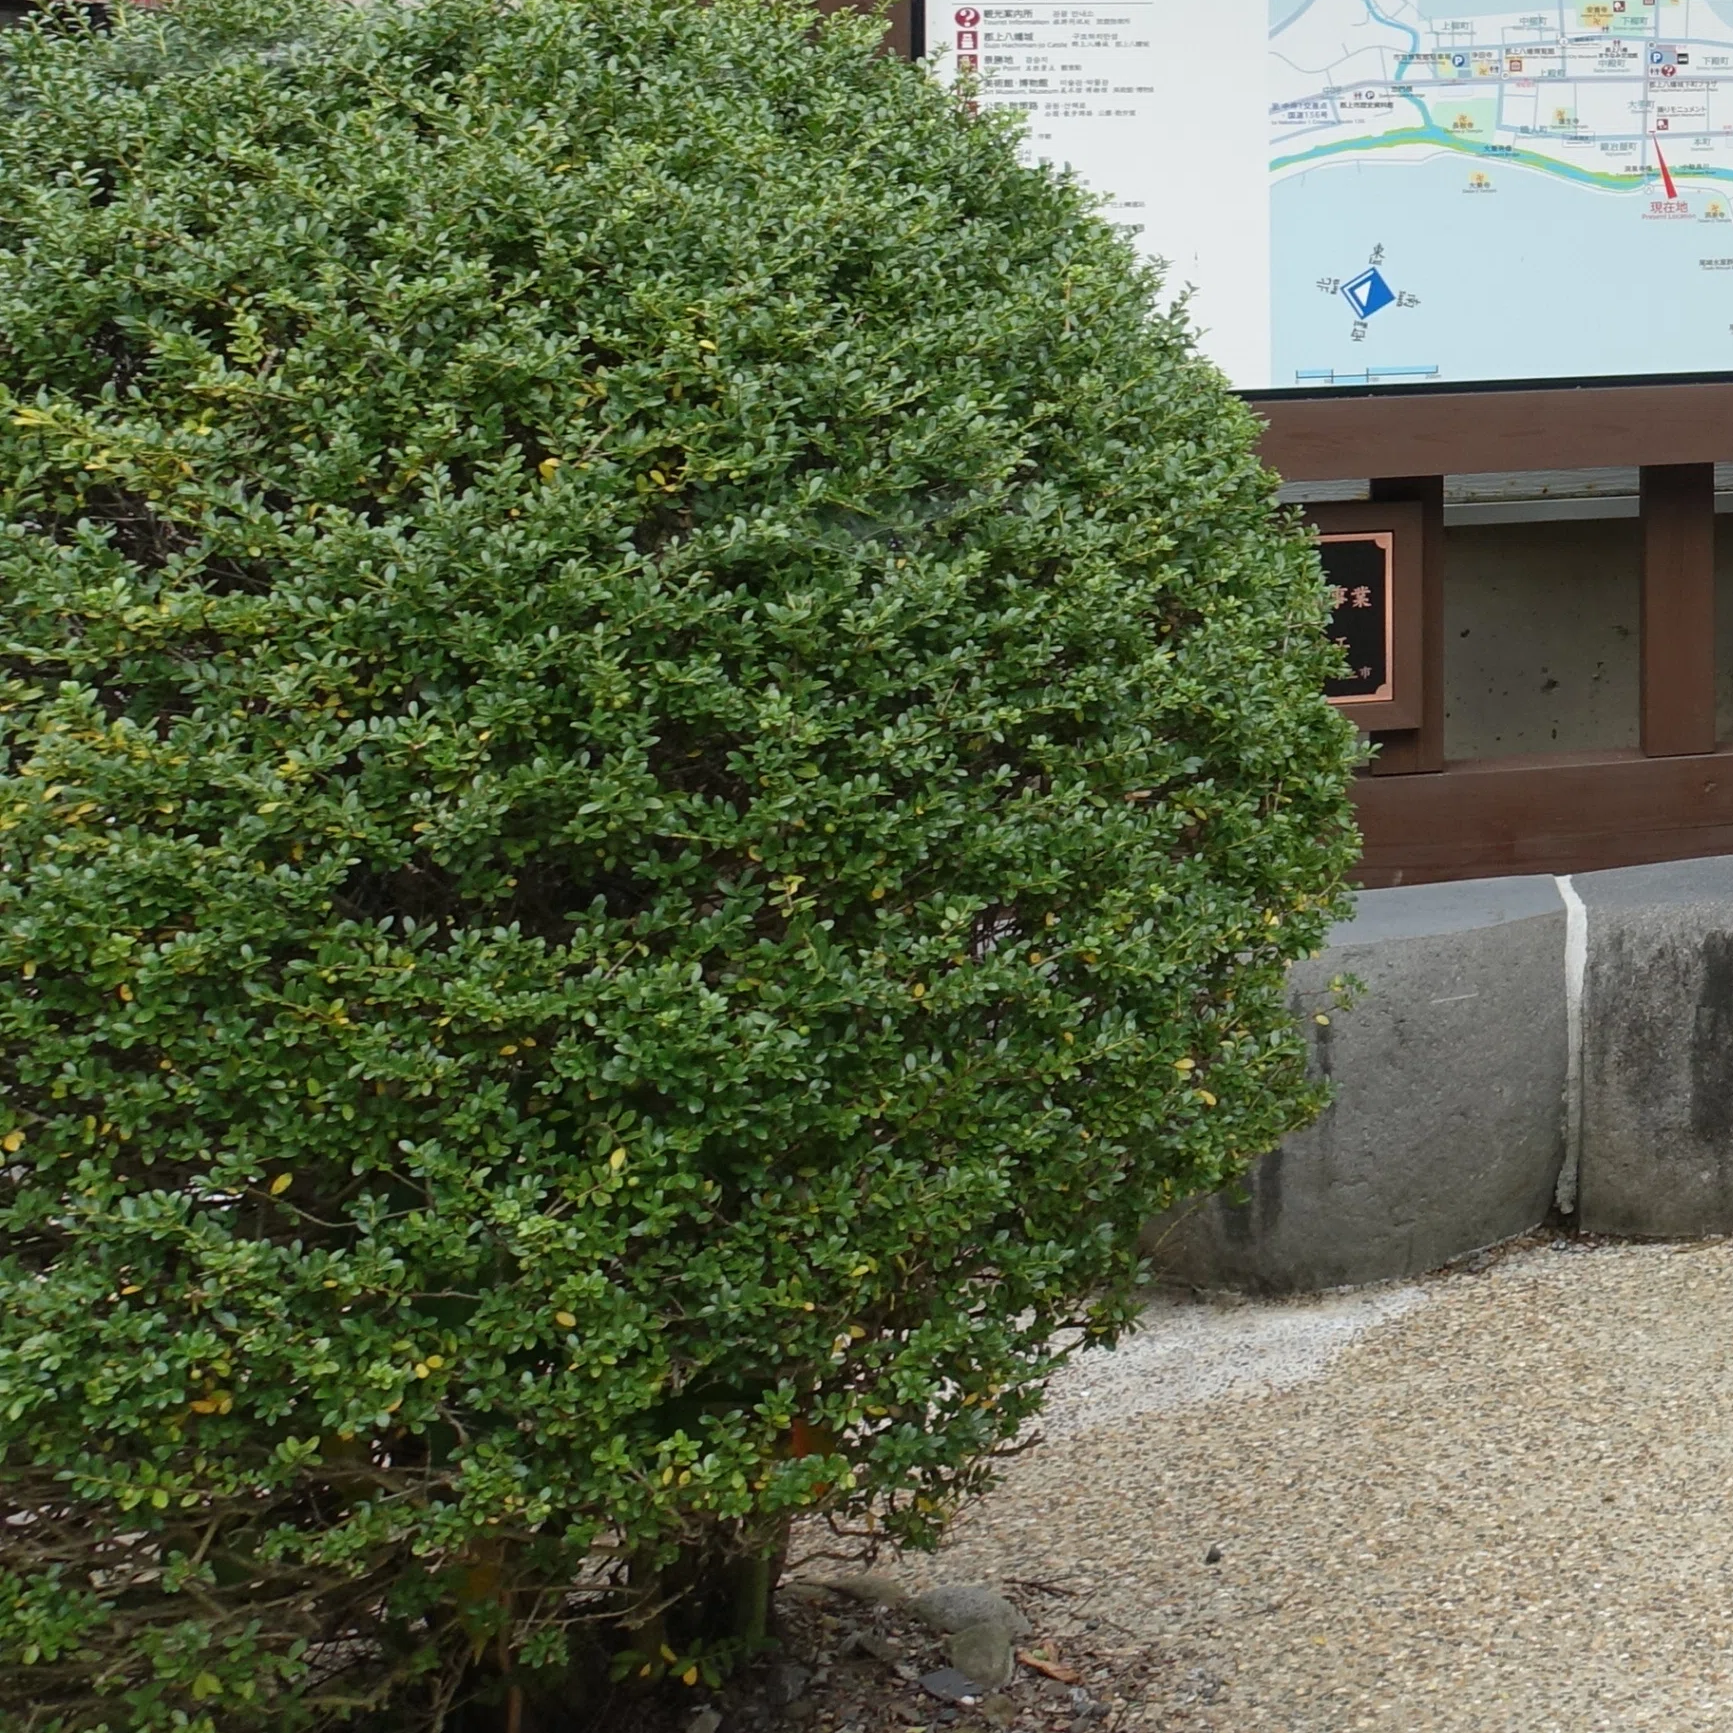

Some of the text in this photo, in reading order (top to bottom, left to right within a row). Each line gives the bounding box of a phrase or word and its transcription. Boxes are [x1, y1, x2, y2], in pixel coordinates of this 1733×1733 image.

[984, 9, 1033, 18] 観光案内所
[984, 32, 1034, 41] 郡上八幡城
[1650, 201, 1688, 214] 現在地
[1642, 212, 1696, 221] Present Location
[1316, 277, 1331, 294] 北
